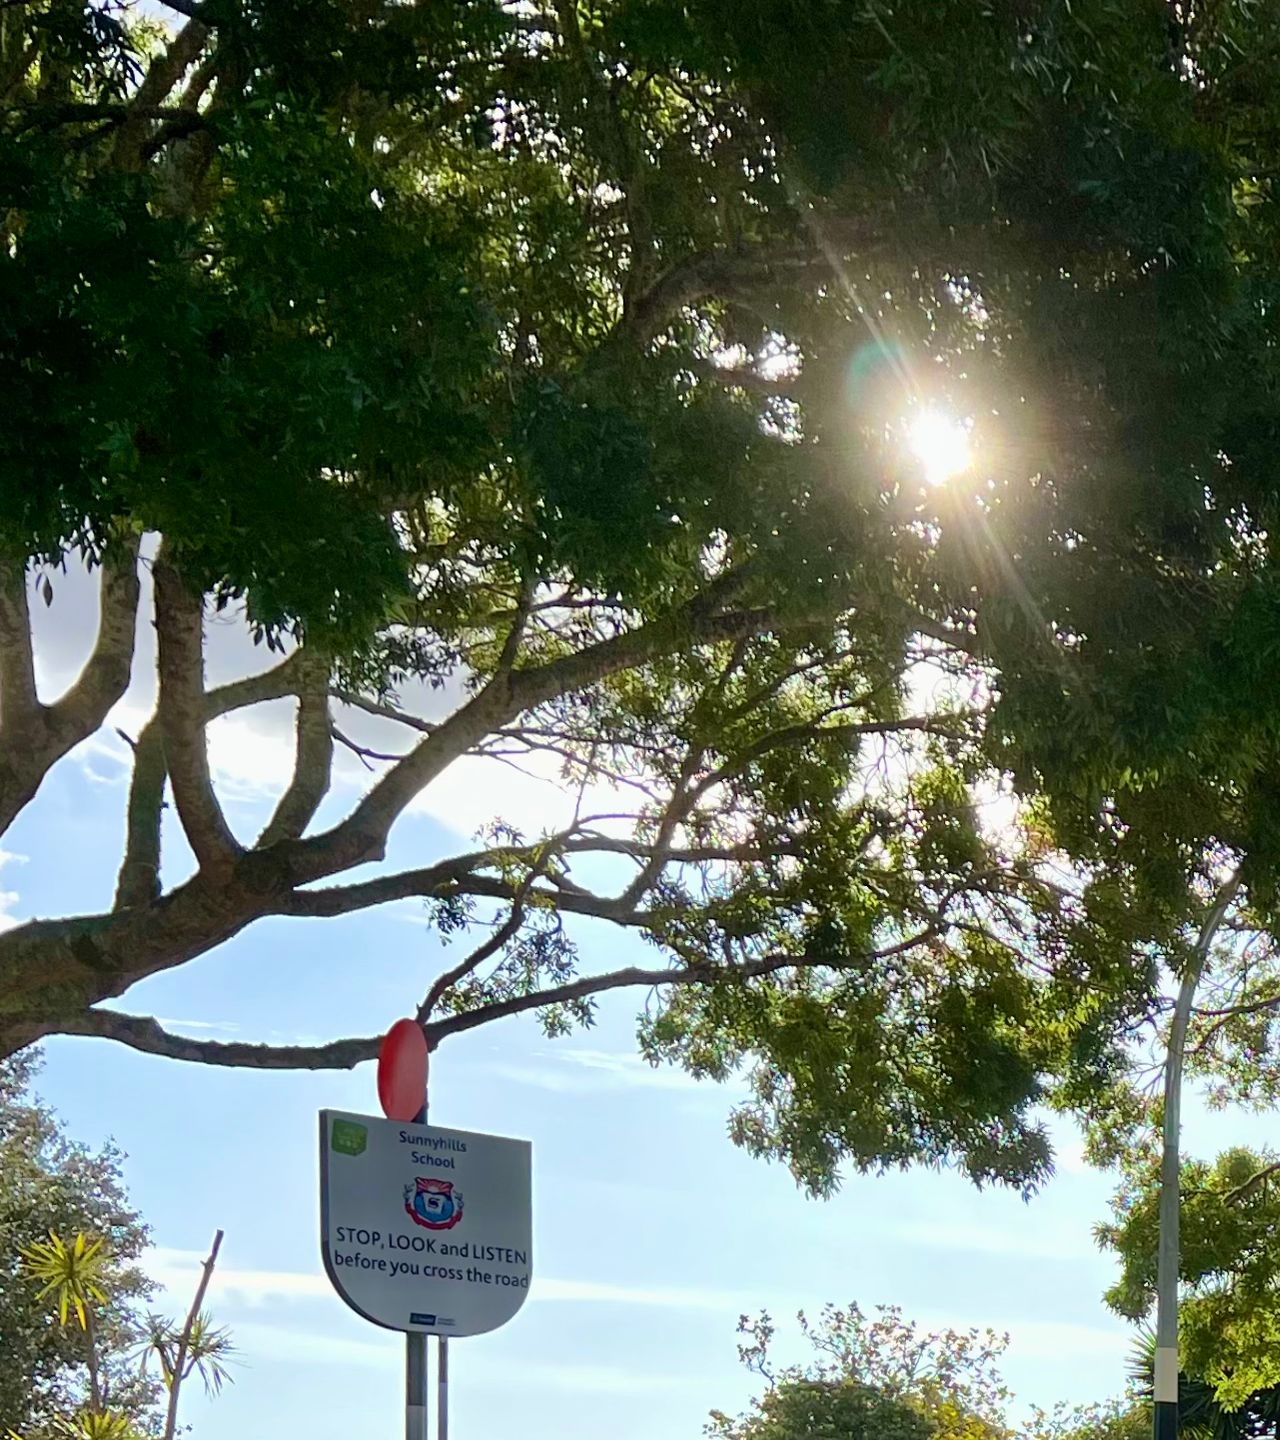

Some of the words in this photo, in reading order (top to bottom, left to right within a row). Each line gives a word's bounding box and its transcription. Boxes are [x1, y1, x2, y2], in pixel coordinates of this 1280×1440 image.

[399, 1131, 467, 1152] Sunnyhills
[411, 1151, 455, 1169] School
[336, 1226, 385, 1250] STOP,
[388, 1233, 437, 1254] LOOK
[440, 1243, 469, 1258] and
[473, 1244, 527, 1265] LISTEN
[334, 1249, 387, 1271] before
[389, 1260, 420, 1277] you
[423, 1265, 464, 1281] cross
[466, 1267, 492, 1284] the
[495, 1273, 529, 1289] road
